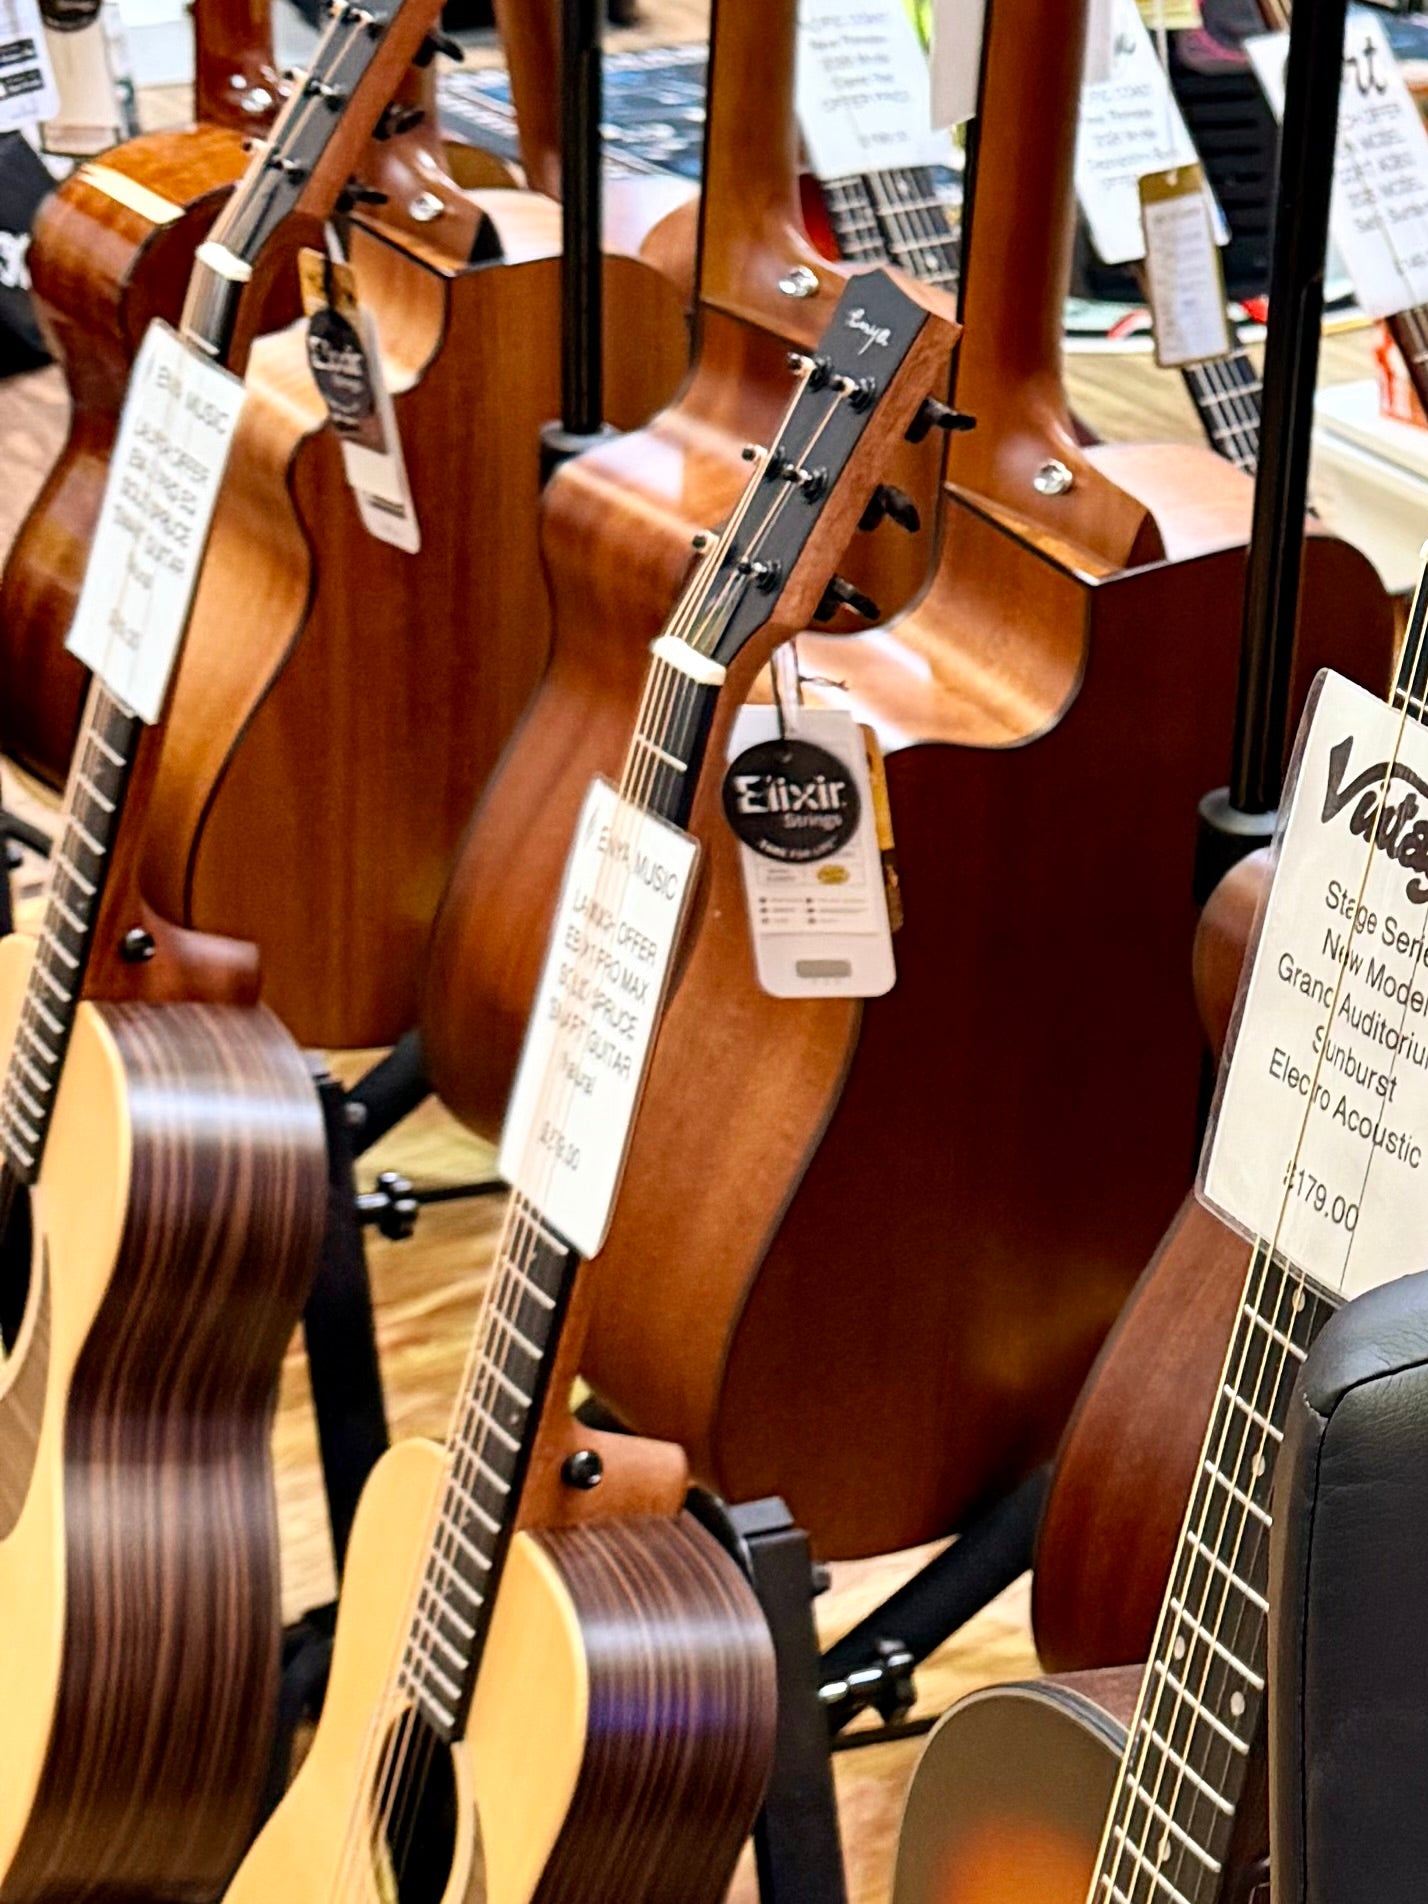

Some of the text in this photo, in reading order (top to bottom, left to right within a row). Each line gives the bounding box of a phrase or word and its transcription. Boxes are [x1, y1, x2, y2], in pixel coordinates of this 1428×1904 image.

[732, 774, 848, 815] Elixir
[633, 852, 680, 902] MUSIC
[1325, 878, 1379, 937] Stage
[1311, 1024, 1398, 1105] Sunburst
[1267, 1046, 1423, 1170] Elecro Acoustic
